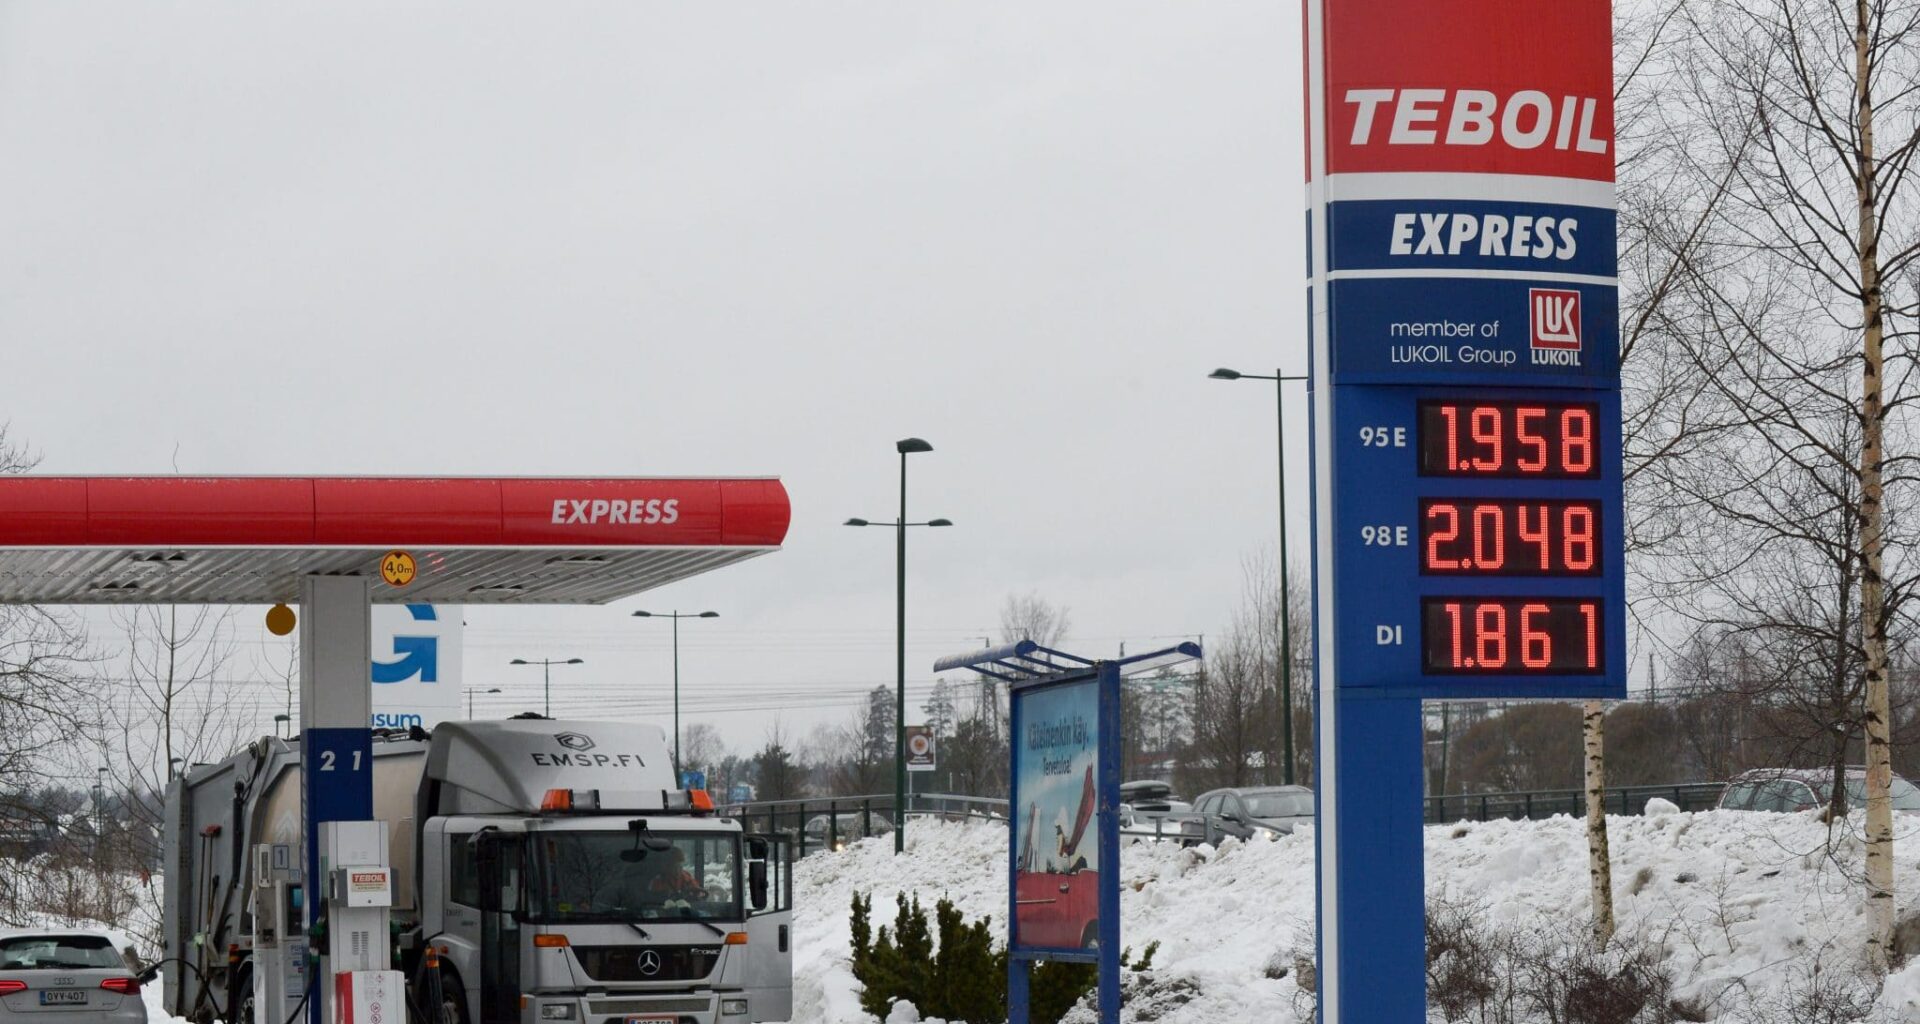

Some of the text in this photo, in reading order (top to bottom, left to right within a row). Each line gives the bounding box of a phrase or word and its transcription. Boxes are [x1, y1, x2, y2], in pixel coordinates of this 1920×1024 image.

[1345, 88, 1607, 154] TEBOIL
[1390, 213, 1578, 260] EXPRESS
[1390, 319, 1500, 338] member of
[1391, 345, 1517, 367] LUKOIL Group
[1531, 350, 1581, 367] LUKOIL
[1359, 427, 1389, 447] 95
[1442, 406, 1592, 472] 1.958
[551, 498, 679, 524] EXPRESS
[1361, 527, 1391, 546] 98
[1428, 504, 1593, 570] 2.048
[1376, 625, 1402, 645] DI
[1446, 603, 1596, 668] 1.861
[320, 750, 362, 771] 2 1
[530, 753, 646, 768] EMSP.FI
[354, 874, 384, 883] TEBOIL
